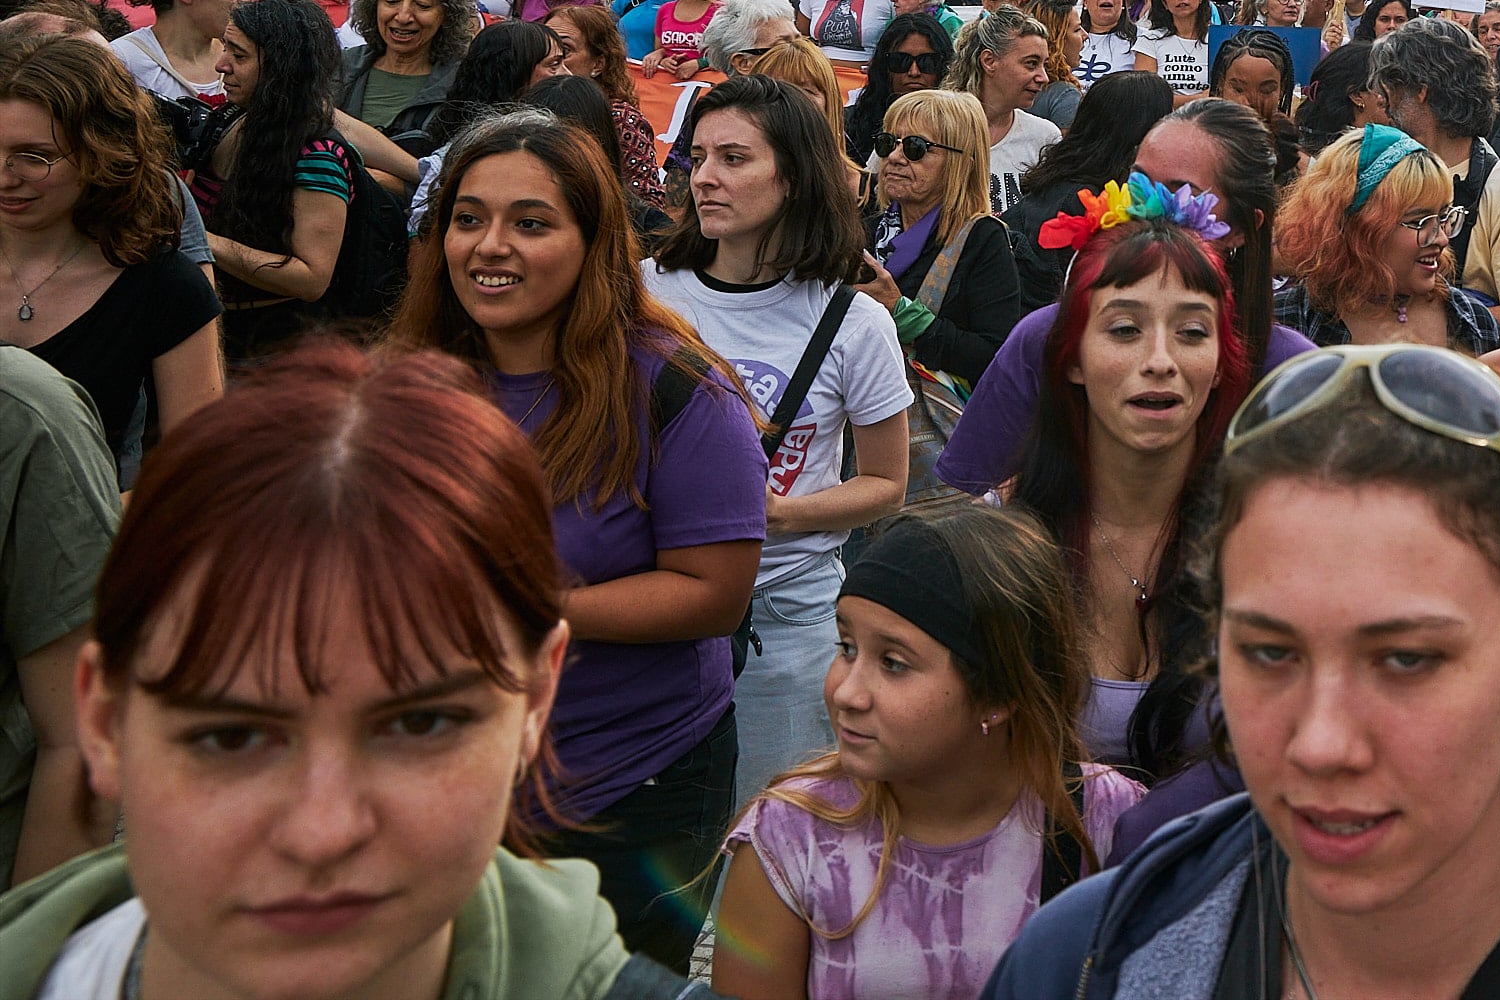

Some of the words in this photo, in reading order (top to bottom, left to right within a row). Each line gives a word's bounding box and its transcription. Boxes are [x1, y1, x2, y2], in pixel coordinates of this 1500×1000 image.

[1165, 53, 1196, 63] Lute
[1164, 64, 1203, 73] como
[1163, 73, 1196, 81] uma
